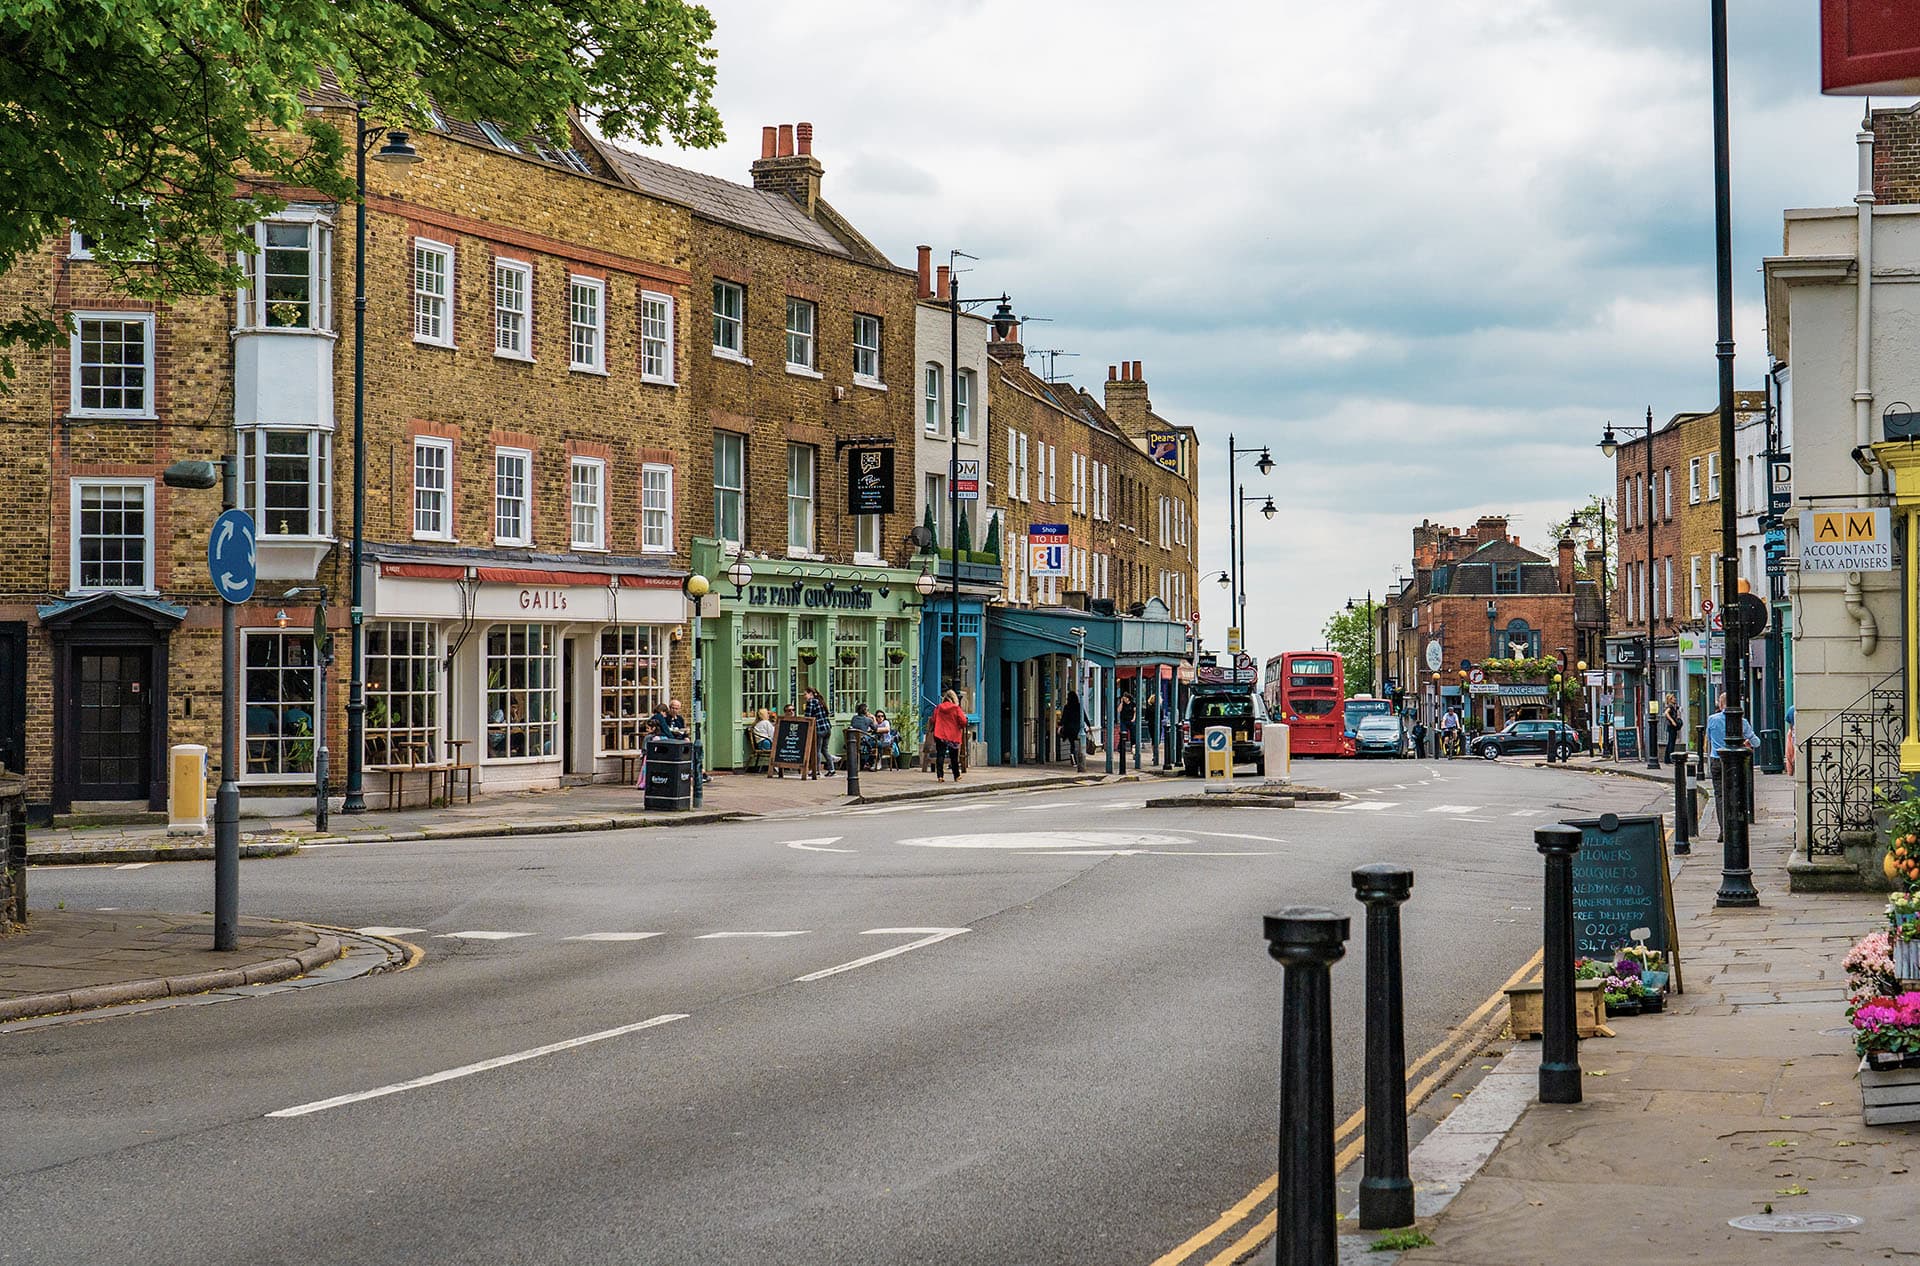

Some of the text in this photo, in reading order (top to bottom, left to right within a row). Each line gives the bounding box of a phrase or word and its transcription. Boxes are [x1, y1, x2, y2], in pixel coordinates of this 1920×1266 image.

[1150, 433, 1175, 448] Pears
[1159, 457, 1177, 467] Soap
[1041, 526, 1057, 534] Shop
[1035, 535, 1064, 544] TO LET
[1803, 543, 1888, 556] ACCOUNTANTS
[1804, 557, 1888, 570] & TAX ADVISERS
[519, 589, 568, 609] GAIL's
[749, 585, 873, 610] LE PAIN QUOTIDIEN
[1579, 849, 1632, 862] FLOWERS
[1572, 866, 1638, 879] BOUQUETS
[1599, 911, 1645, 921] DELIVERY
